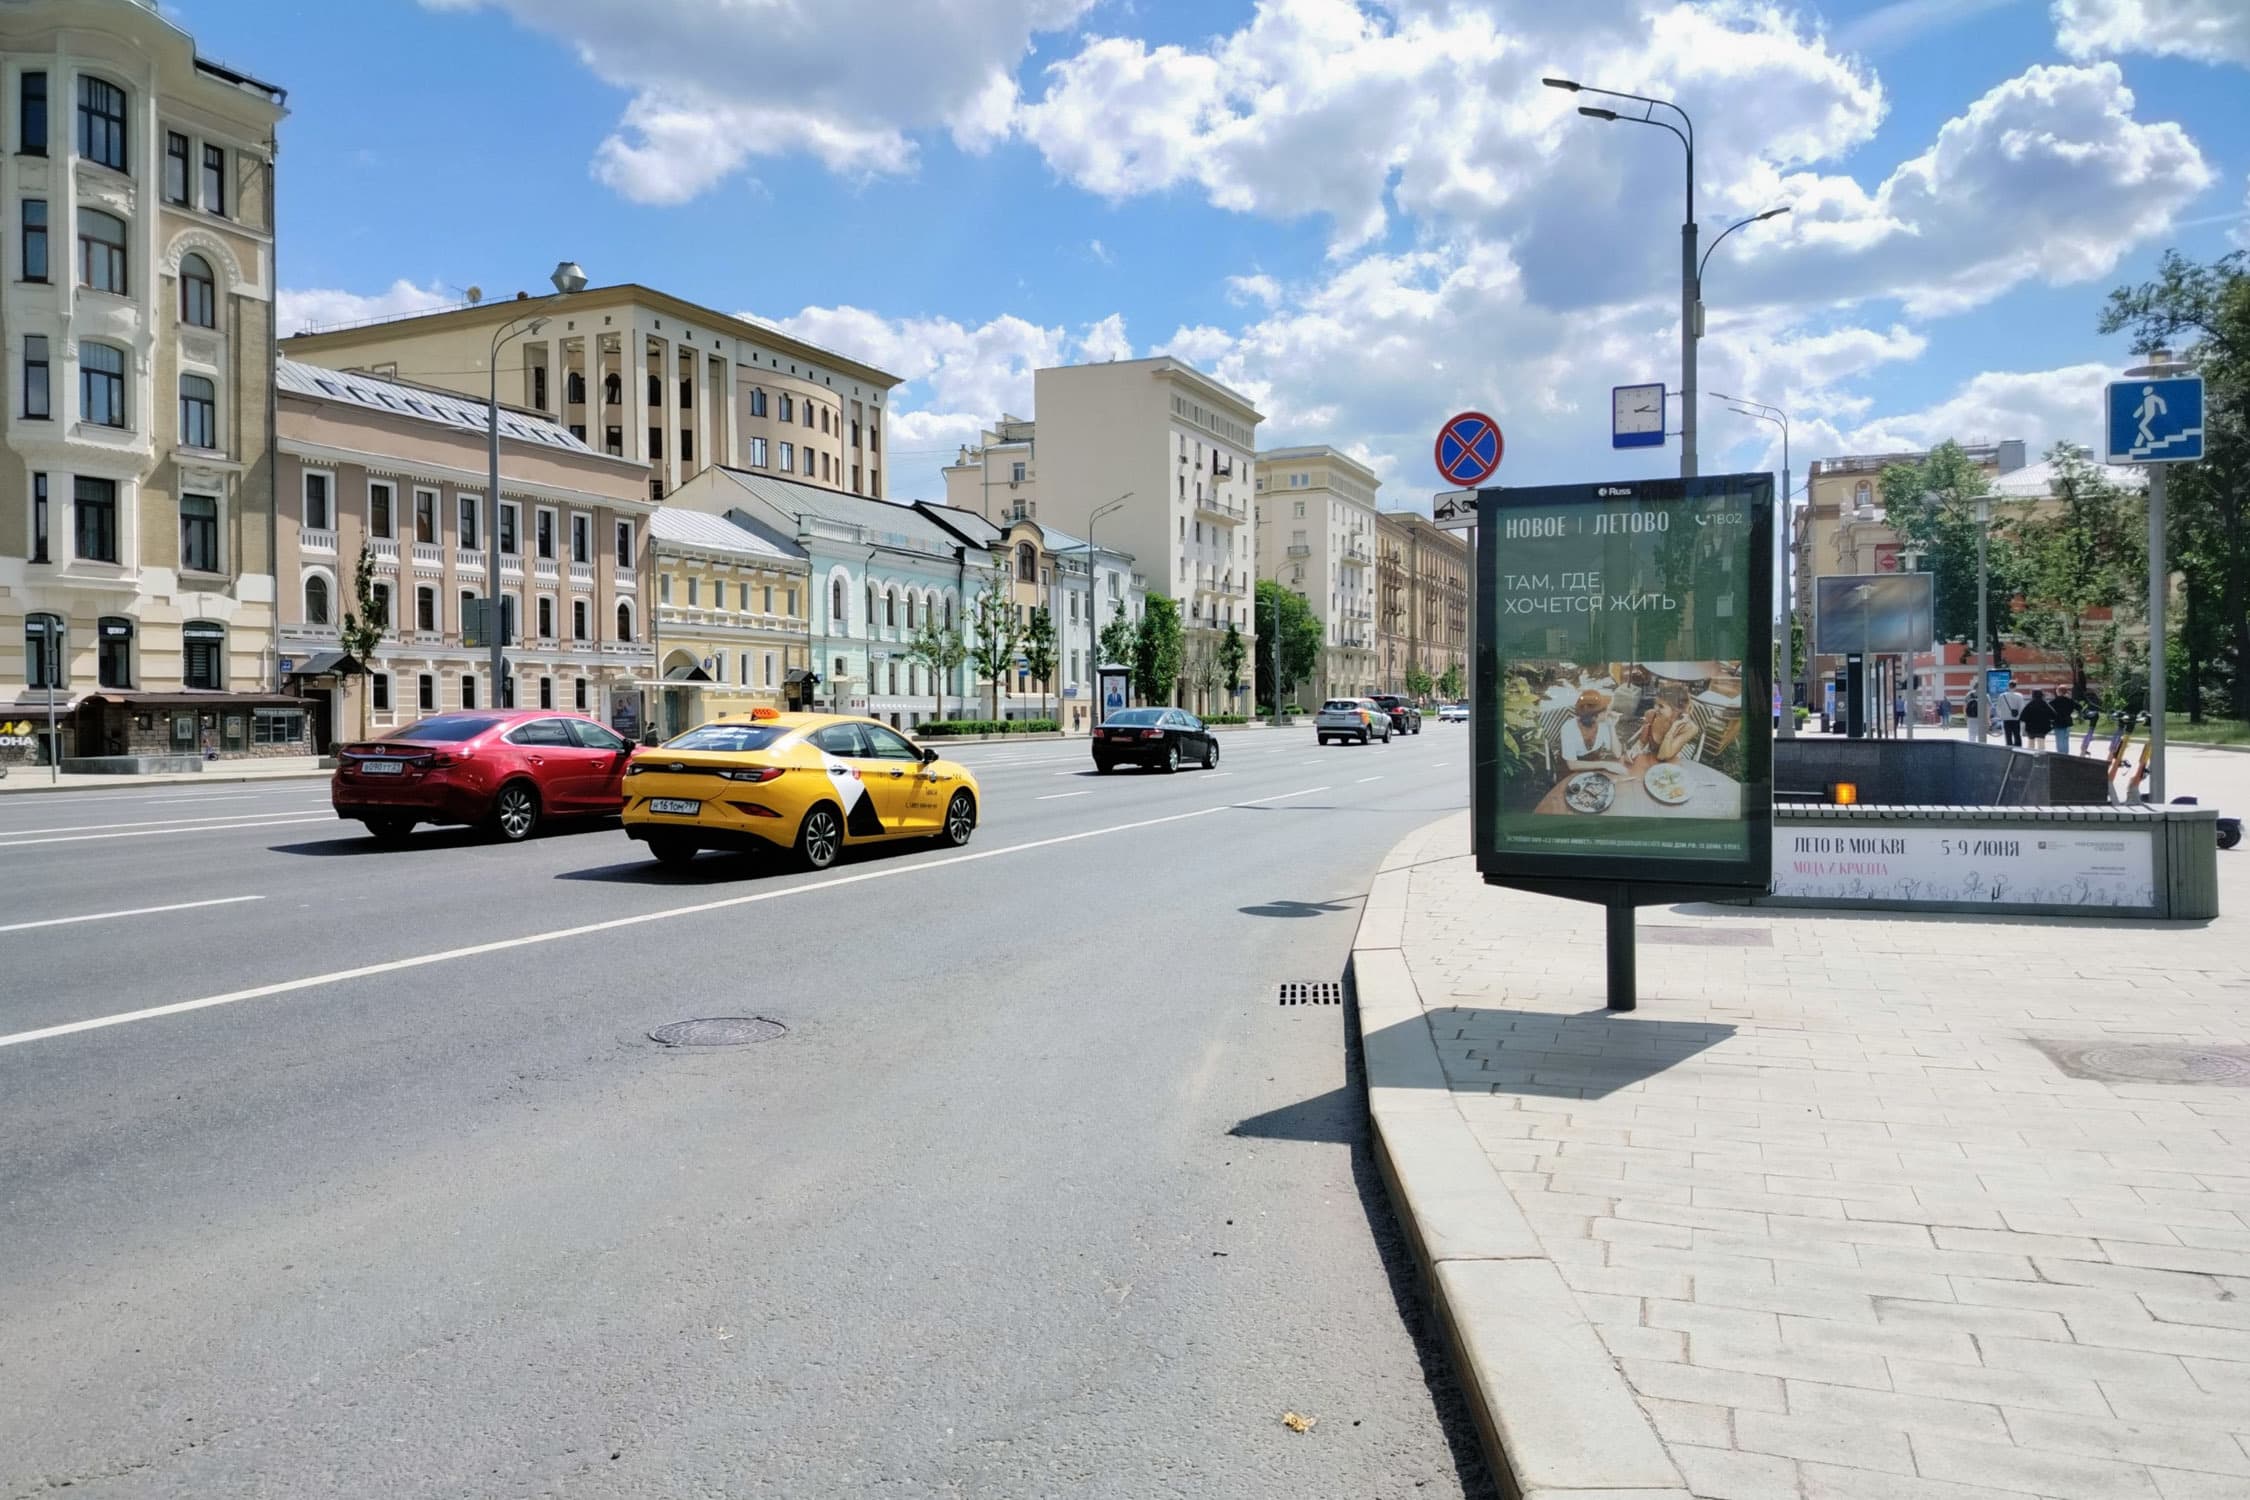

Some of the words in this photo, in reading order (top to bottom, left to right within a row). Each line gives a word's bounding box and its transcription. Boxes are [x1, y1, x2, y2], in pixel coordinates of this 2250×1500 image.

[1608, 487, 1632, 496] Russ
[1505, 515, 1567, 539] НОВОЕ
[1592, 511, 1670, 535] ЛЕТОВО
[1504, 573, 1555, 592] ТАМ,
[1561, 571, 1601, 592] ГДЕ
[1504, 595, 1603, 614] ХОЧЕТСЯ
[1609, 593, 1676, 612] ЖИТЬ
[1794, 837, 1830, 853] ЛЕТО
[1835, 837, 1845, 854] В
[1973, 839, 2019, 857] ИЮНЯ
[1793, 861, 1825, 876] МОДА
[1839, 862, 1888, 876] КРАСОТА
